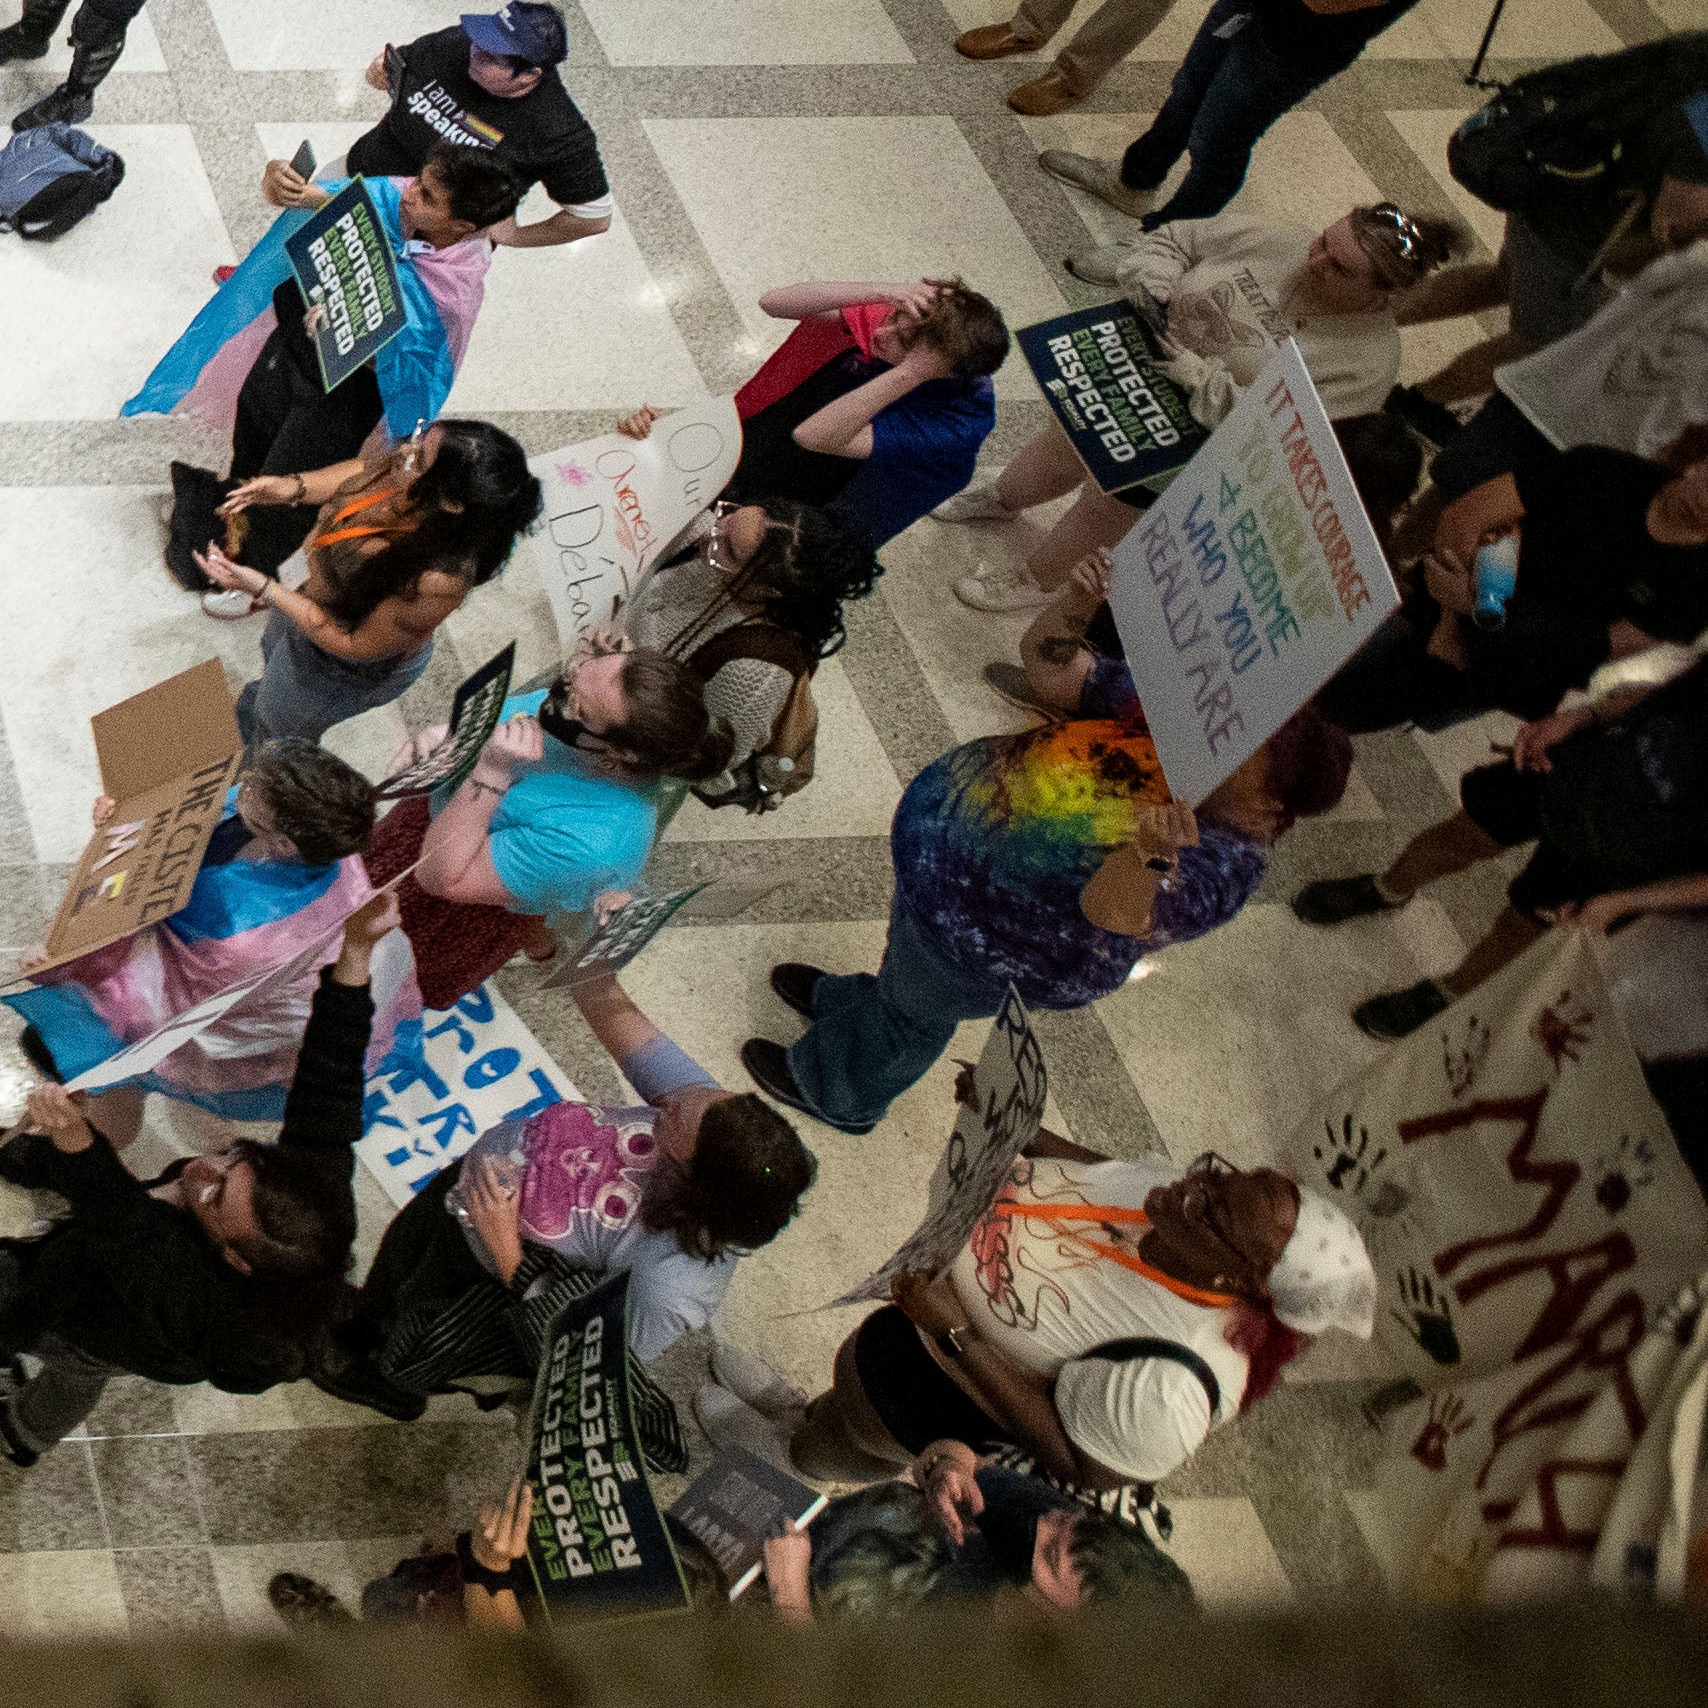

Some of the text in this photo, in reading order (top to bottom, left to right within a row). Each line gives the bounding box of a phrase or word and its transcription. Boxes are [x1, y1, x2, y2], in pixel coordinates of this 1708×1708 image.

[407, 91, 482, 148] speakin
[428, 85, 459, 116] am
[307, 235, 355, 357] RESPECTED
[322, 225, 370, 341] EVERY FAMILY
[335, 211, 384, 332] PROTECTED
[352, 201, 397, 316] EVERY STUDENT
[1046, 333, 1137, 463] RESPECTED
[1071, 327, 1159, 452] EVERY FAMILY
[1090, 319, 1180, 447] PROTECTED
[1264, 376, 1372, 624] IT TAKES COURAGE
[1139, 510, 1246, 758] REALLY ARE
[1181, 492, 1261, 676] WHO YOU
[1227, 508, 1302, 658] BECOME
[175, 755, 234, 824] THE
[540, 1333, 594, 1580] PROTECTED
[562, 1329, 614, 1573] EVERY FAMILY
[579, 1315, 643, 1570] RESPECTED
